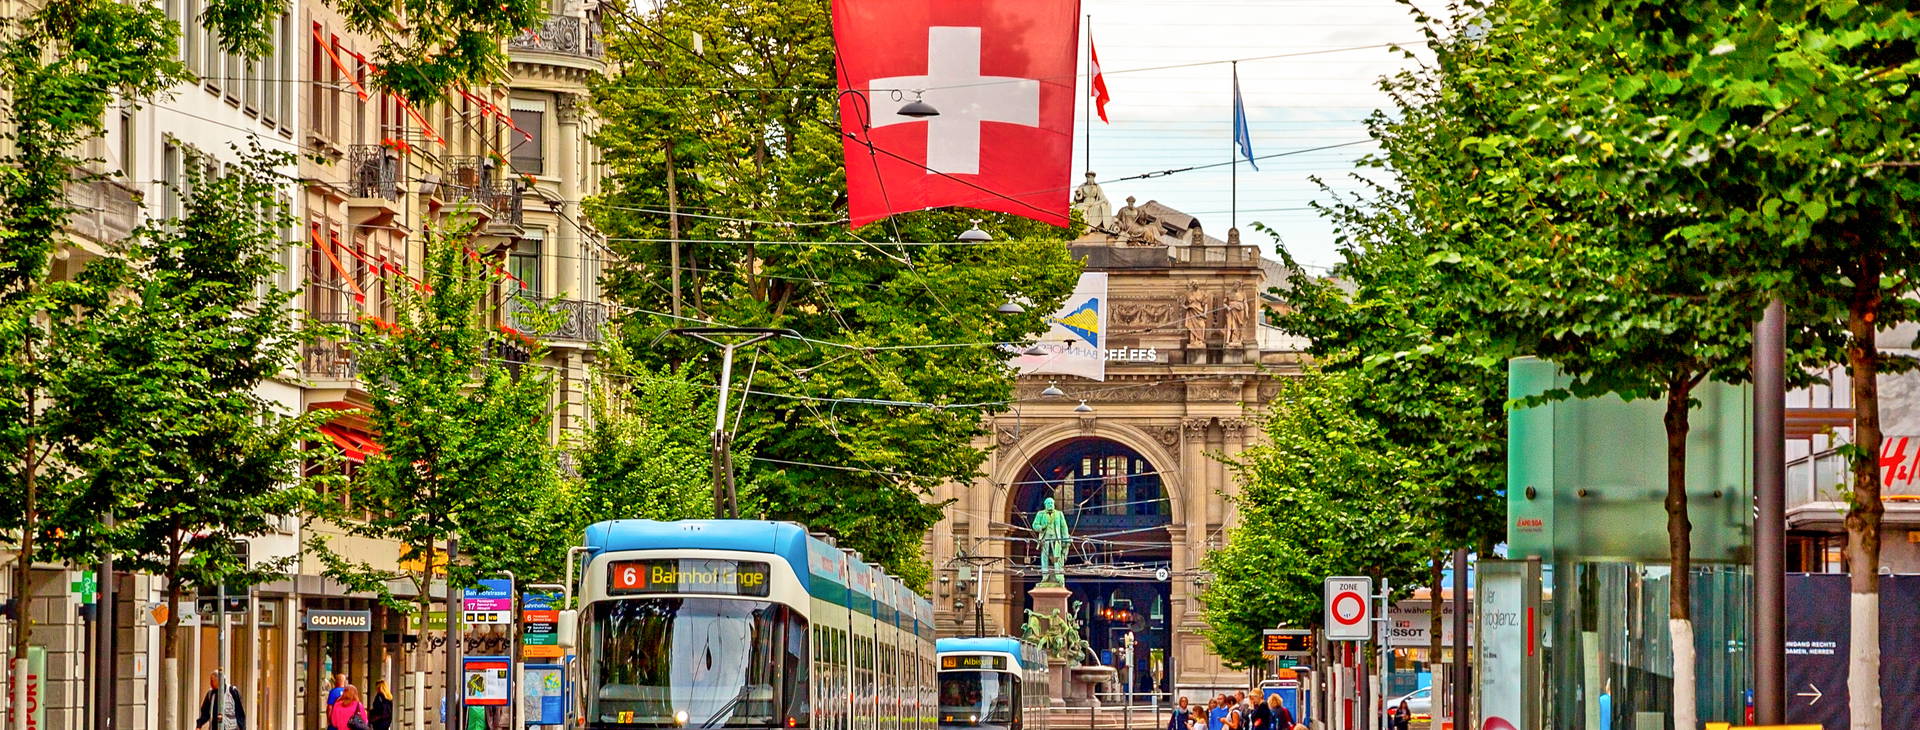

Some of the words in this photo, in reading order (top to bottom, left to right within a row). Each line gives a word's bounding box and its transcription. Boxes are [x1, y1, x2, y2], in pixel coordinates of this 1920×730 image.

[623, 567, 636, 586] 6
[652, 566, 718, 584] Bahnhof
[723, 568, 764, 587] Enge
[1340, 583, 1358, 591] ZONE
[467, 602, 476, 610] 17
[1387, 606, 1402, 615] uch
[311, 615, 365, 626] GOLDHAUS
[527, 614, 532, 622] 6
[527, 625, 532, 633] 7
[524, 637, 532, 645] 11
